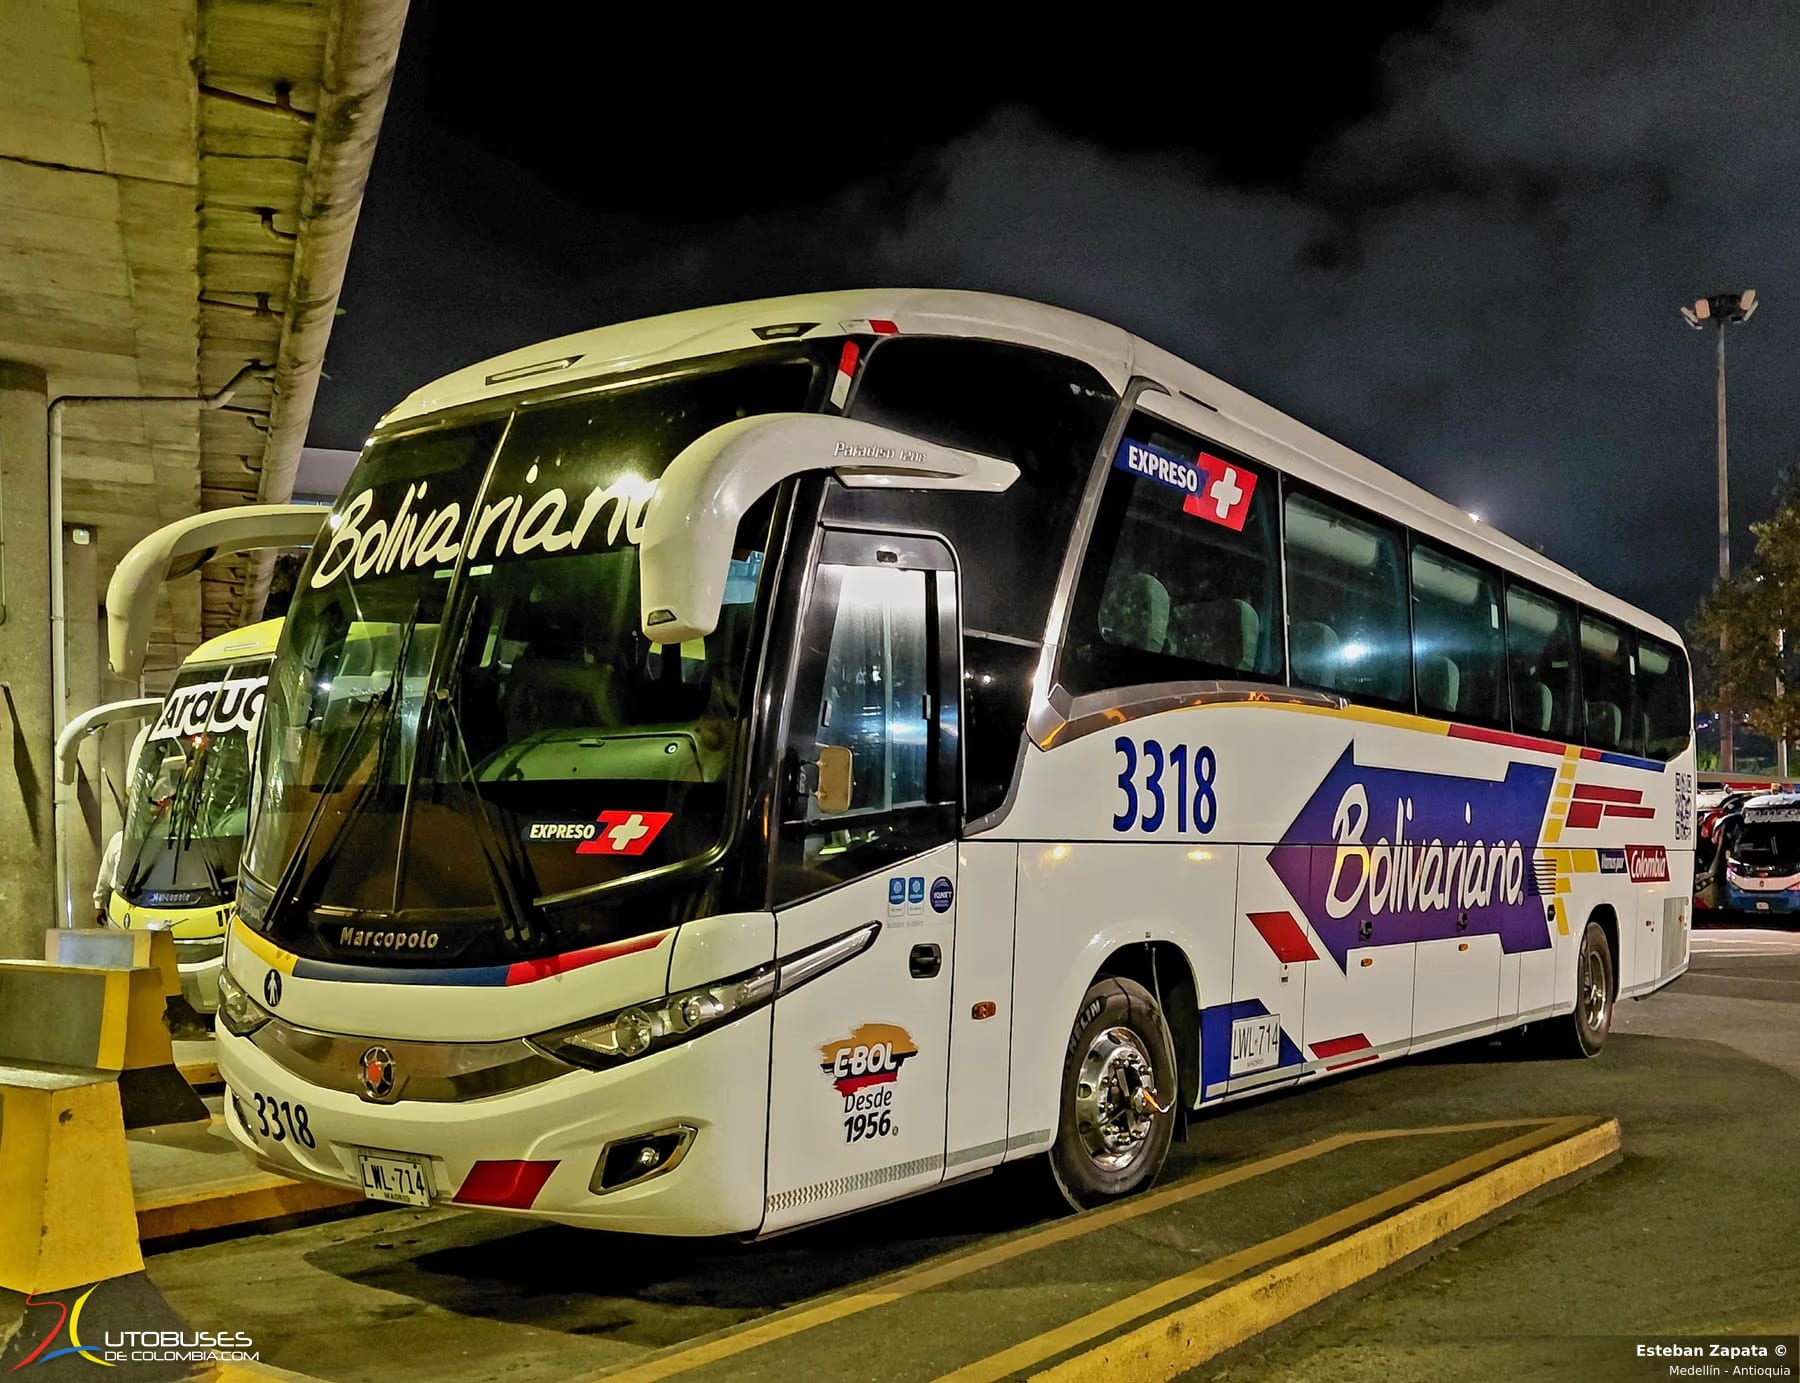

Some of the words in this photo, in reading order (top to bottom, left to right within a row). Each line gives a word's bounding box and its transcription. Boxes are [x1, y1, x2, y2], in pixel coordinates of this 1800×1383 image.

[833, 441, 895, 459] Paradiso
[1128, 445, 1198, 492] EXPRESO
[1112, 736, 1217, 835] 3318
[529, 824, 596, 839] EXPRESO
[1325, 783, 1524, 919] Bolivariano
[1631, 850, 1667, 879] Colombia
[340, 926, 439, 951] Marcopolo
[844, 1086, 893, 1113] Desde
[253, 1092, 316, 1149] 3318
[844, 1109, 892, 1143] 1956
